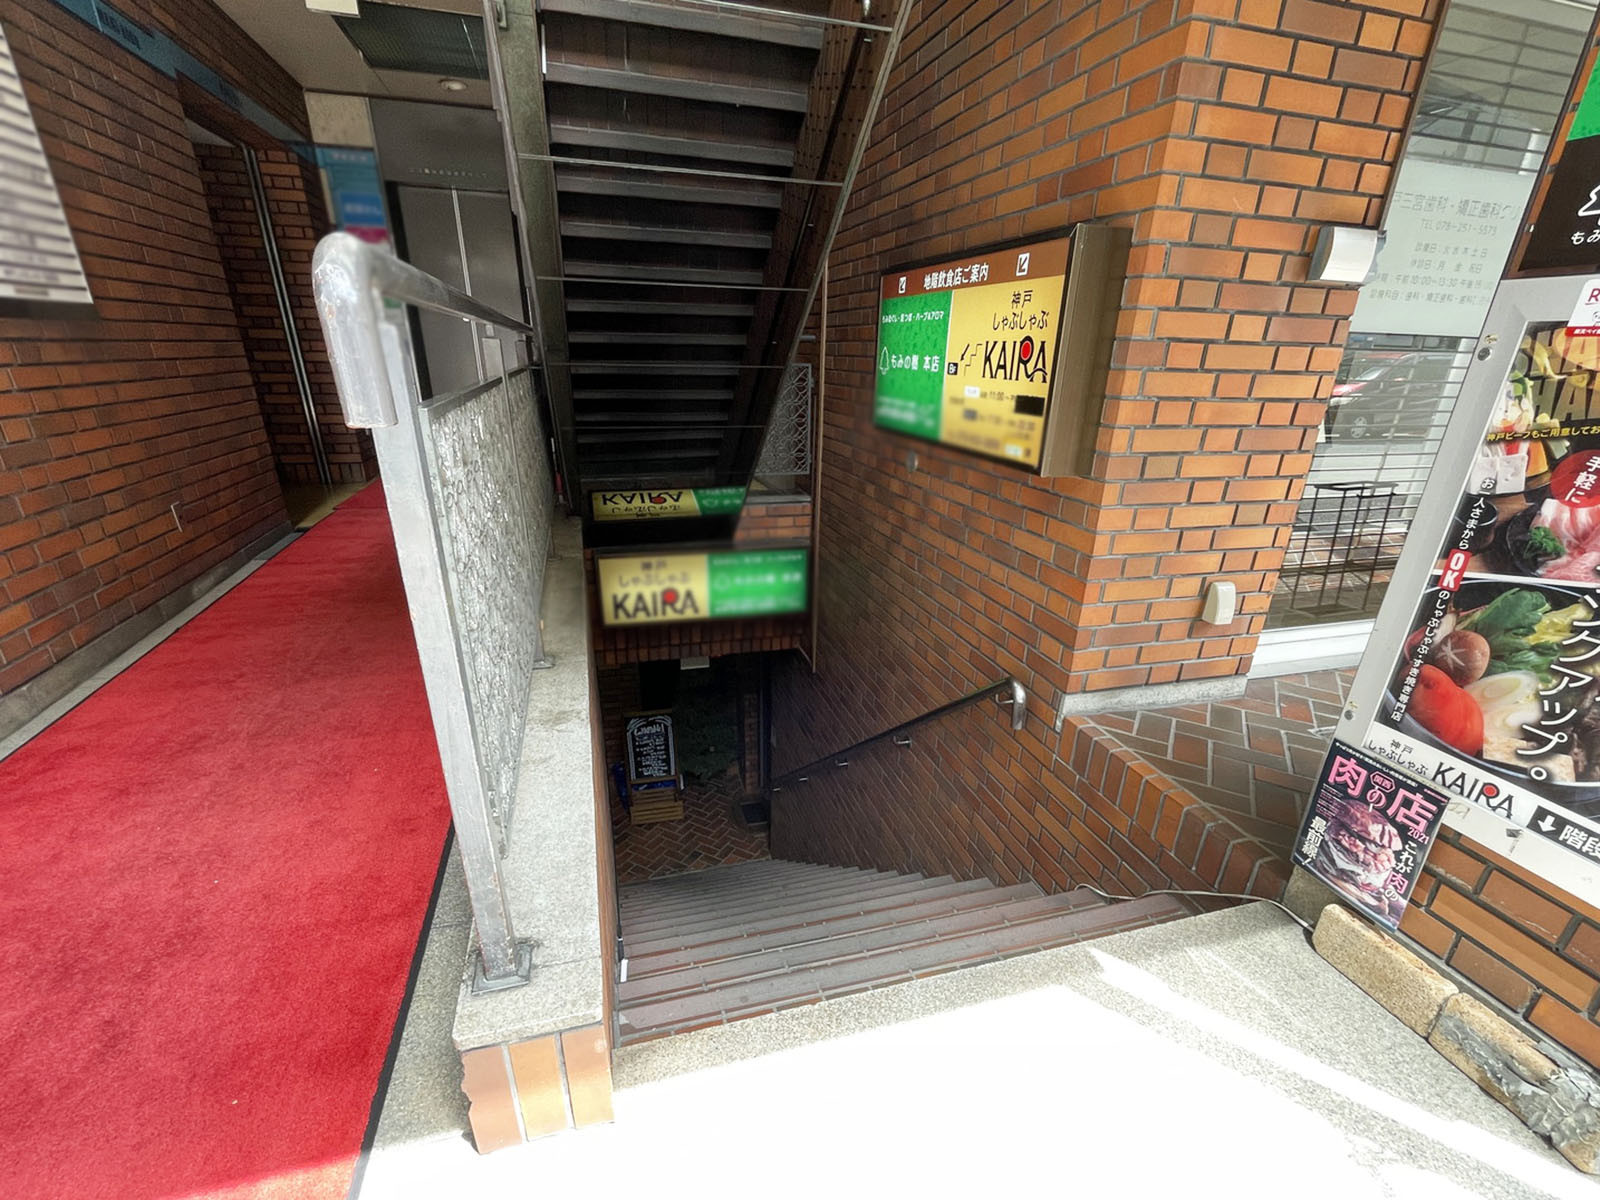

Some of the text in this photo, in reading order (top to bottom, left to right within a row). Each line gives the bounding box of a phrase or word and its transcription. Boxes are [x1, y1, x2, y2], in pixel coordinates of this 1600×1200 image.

[923, 262, 989, 290] 地階飲食店ご案内
[1011, 290, 1033, 309] 神戸
[992, 310, 1049, 331] しゃぶしゃぶ
[982, 335, 1048, 383] KAIRA
[612, 587, 700, 620] KAIRA
[1369, 739, 1429, 776] しゃぶしゃぶ
[1390, 739, 1414, 754] 神戸
[1432, 761, 1516, 820] KAIRA
[1407, 826, 1430, 845] 2021
